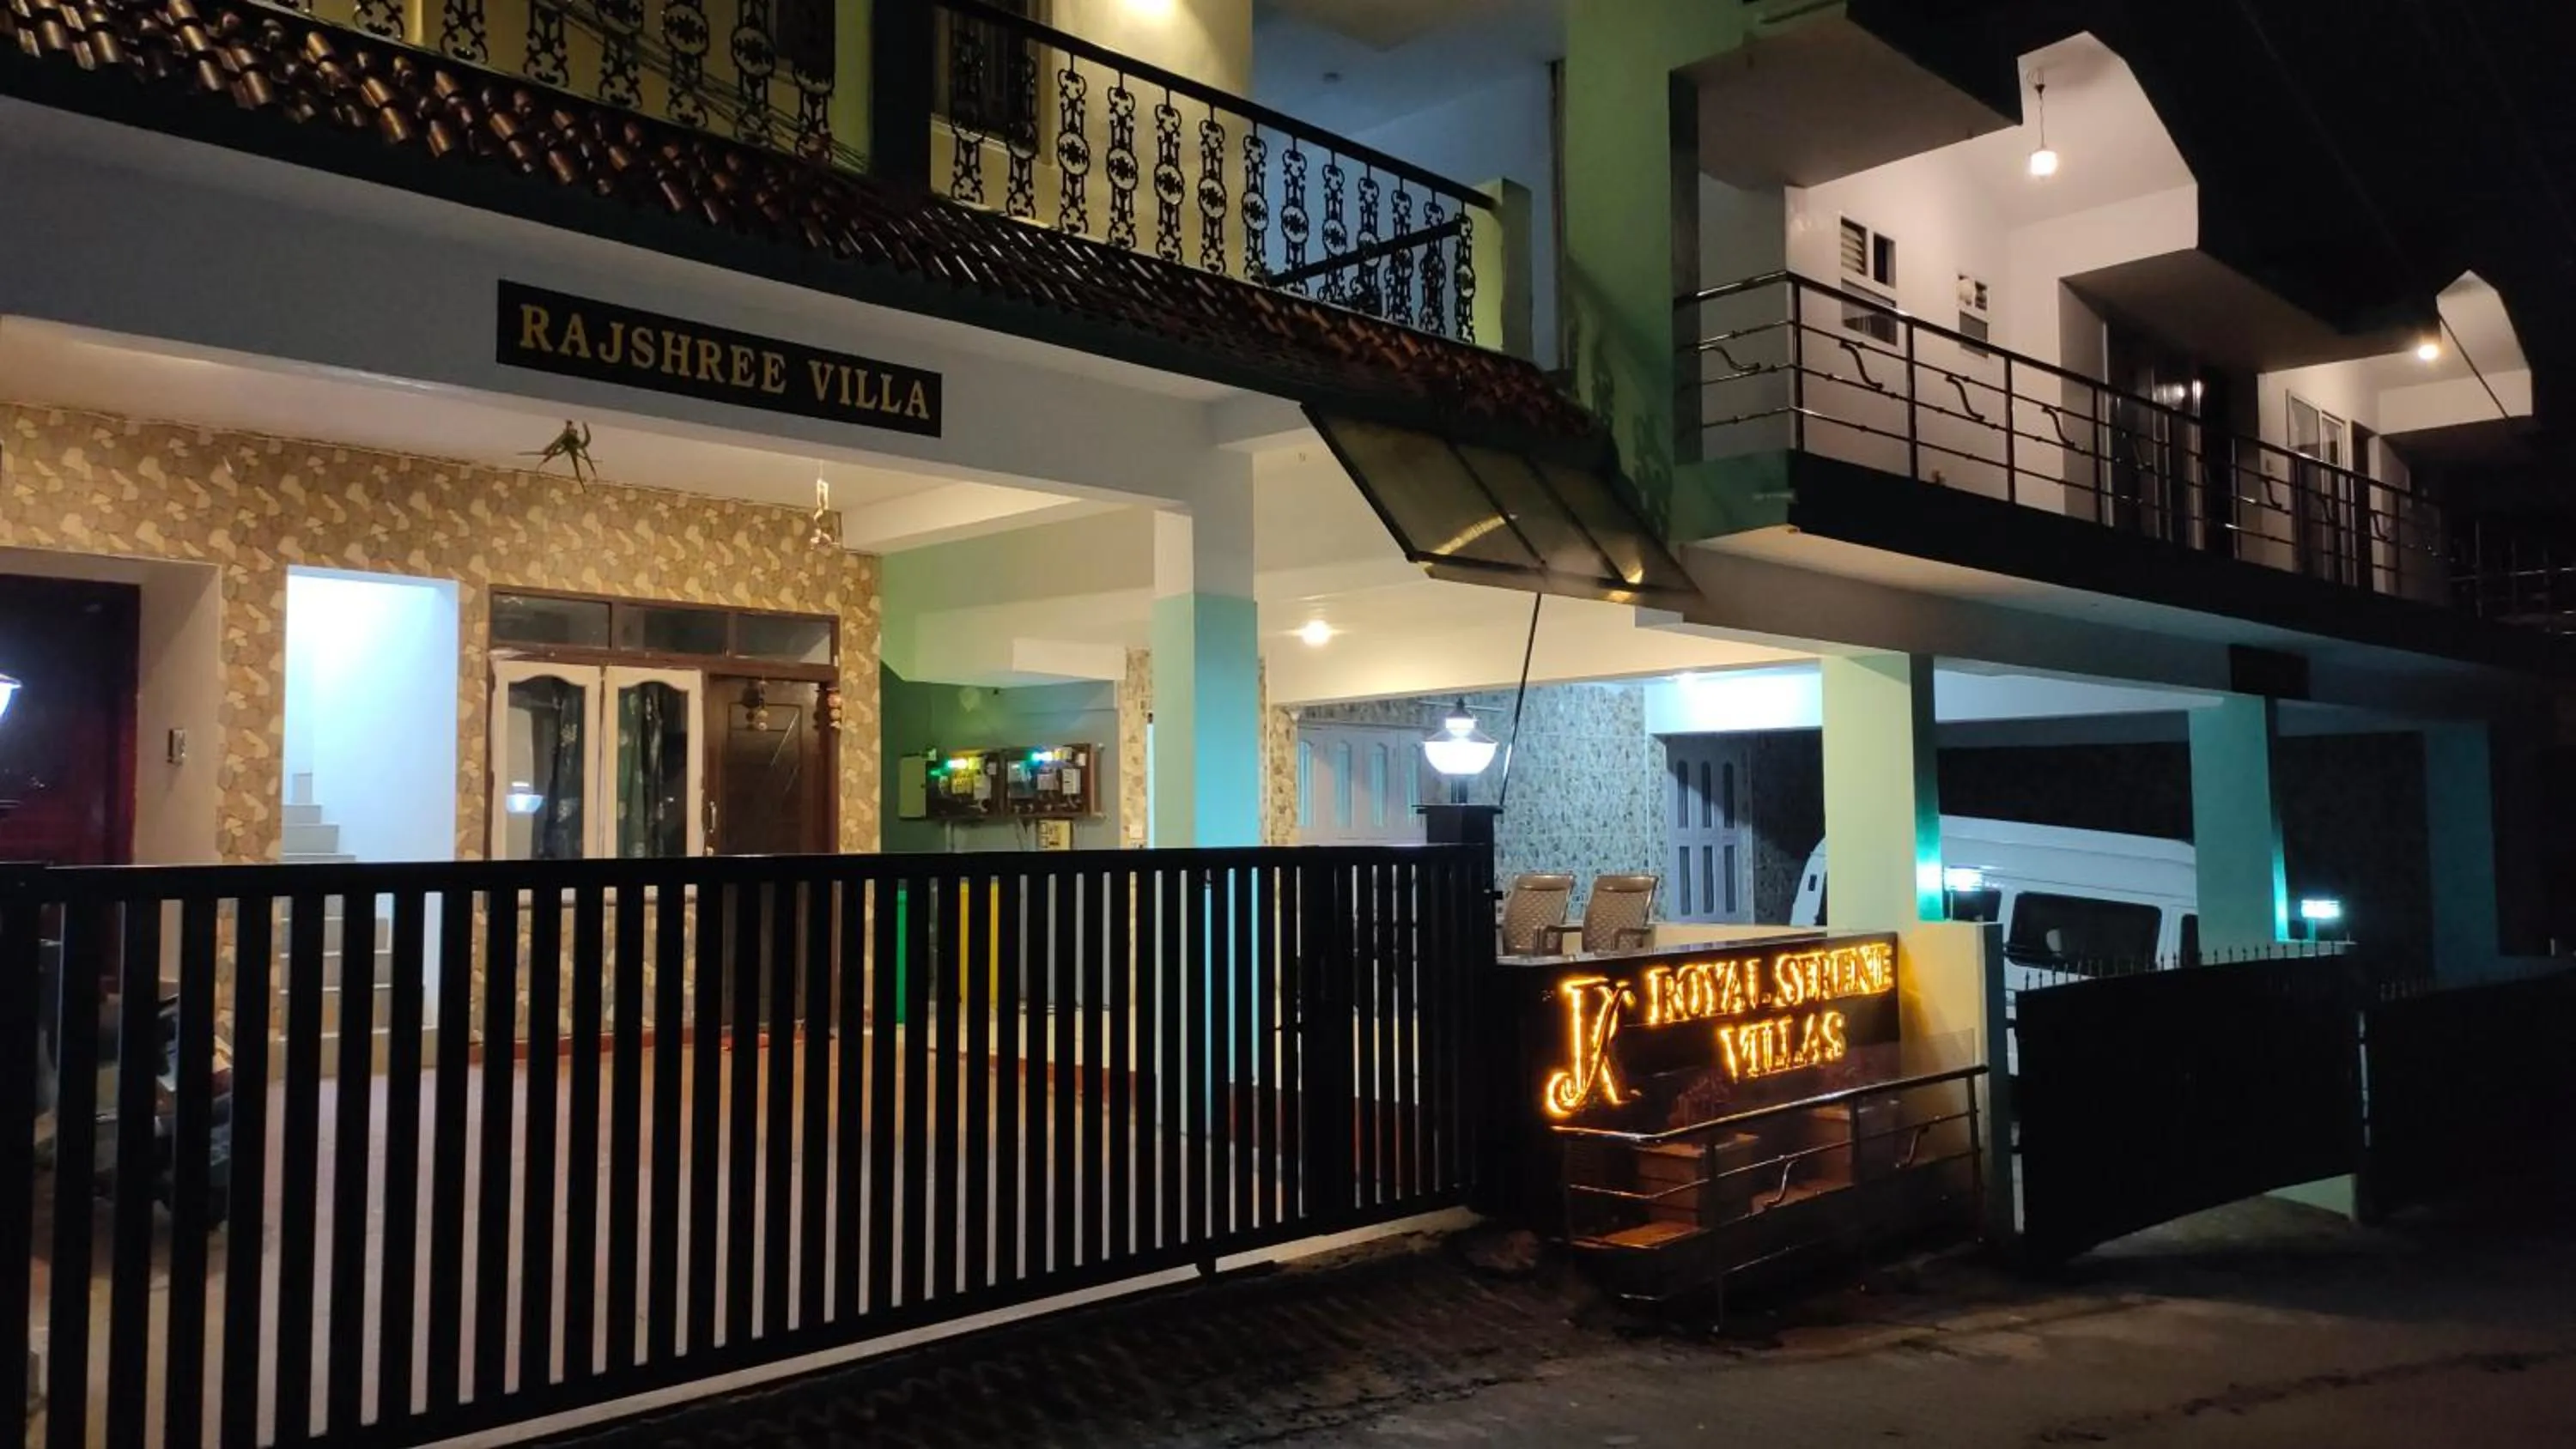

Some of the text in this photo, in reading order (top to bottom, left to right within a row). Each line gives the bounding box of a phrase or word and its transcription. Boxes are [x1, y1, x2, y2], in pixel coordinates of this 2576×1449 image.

[519, 303, 930, 421] RAJSHREE VILLA
[1645, 942, 1894, 1026] ROYAL SERENE
[1719, 1011, 1846, 1083] VILLAS
